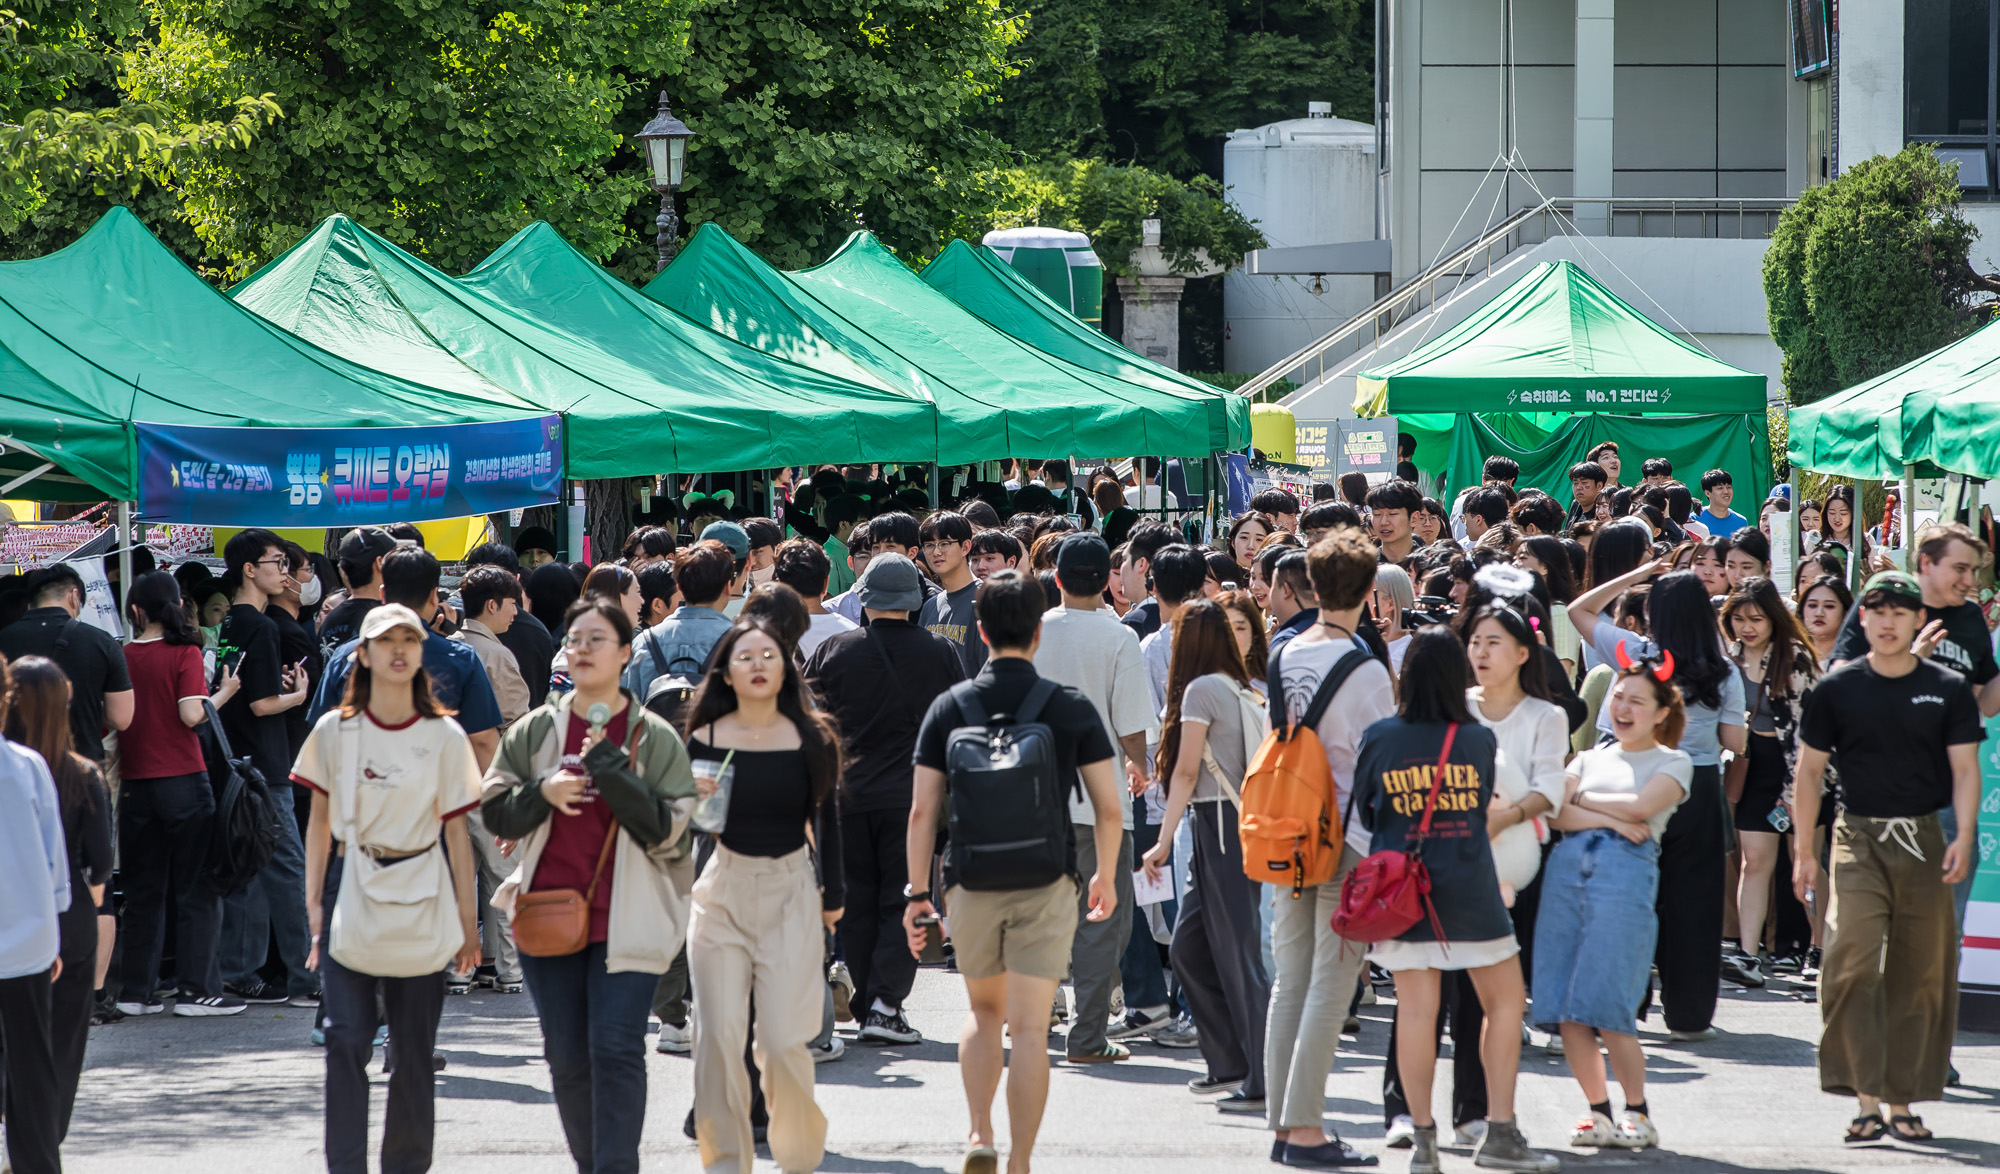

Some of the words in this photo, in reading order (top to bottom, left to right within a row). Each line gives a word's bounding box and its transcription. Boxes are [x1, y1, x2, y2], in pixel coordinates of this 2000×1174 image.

[1520, 390, 1571, 403] 숙취해소
[1585, 389, 1617, 403] No.1
[1619, 389, 1658, 403] 컨디션
[181, 461, 207, 488] 도전!
[243, 464, 273, 492] 챌린지
[334, 446, 390, 504] 큐피트
[391, 443, 449, 500] 오락실
[465, 457, 500, 484] 경희대생협
[501, 454, 534, 480] 학생위원회
[534, 451, 551, 475] 큐피트
